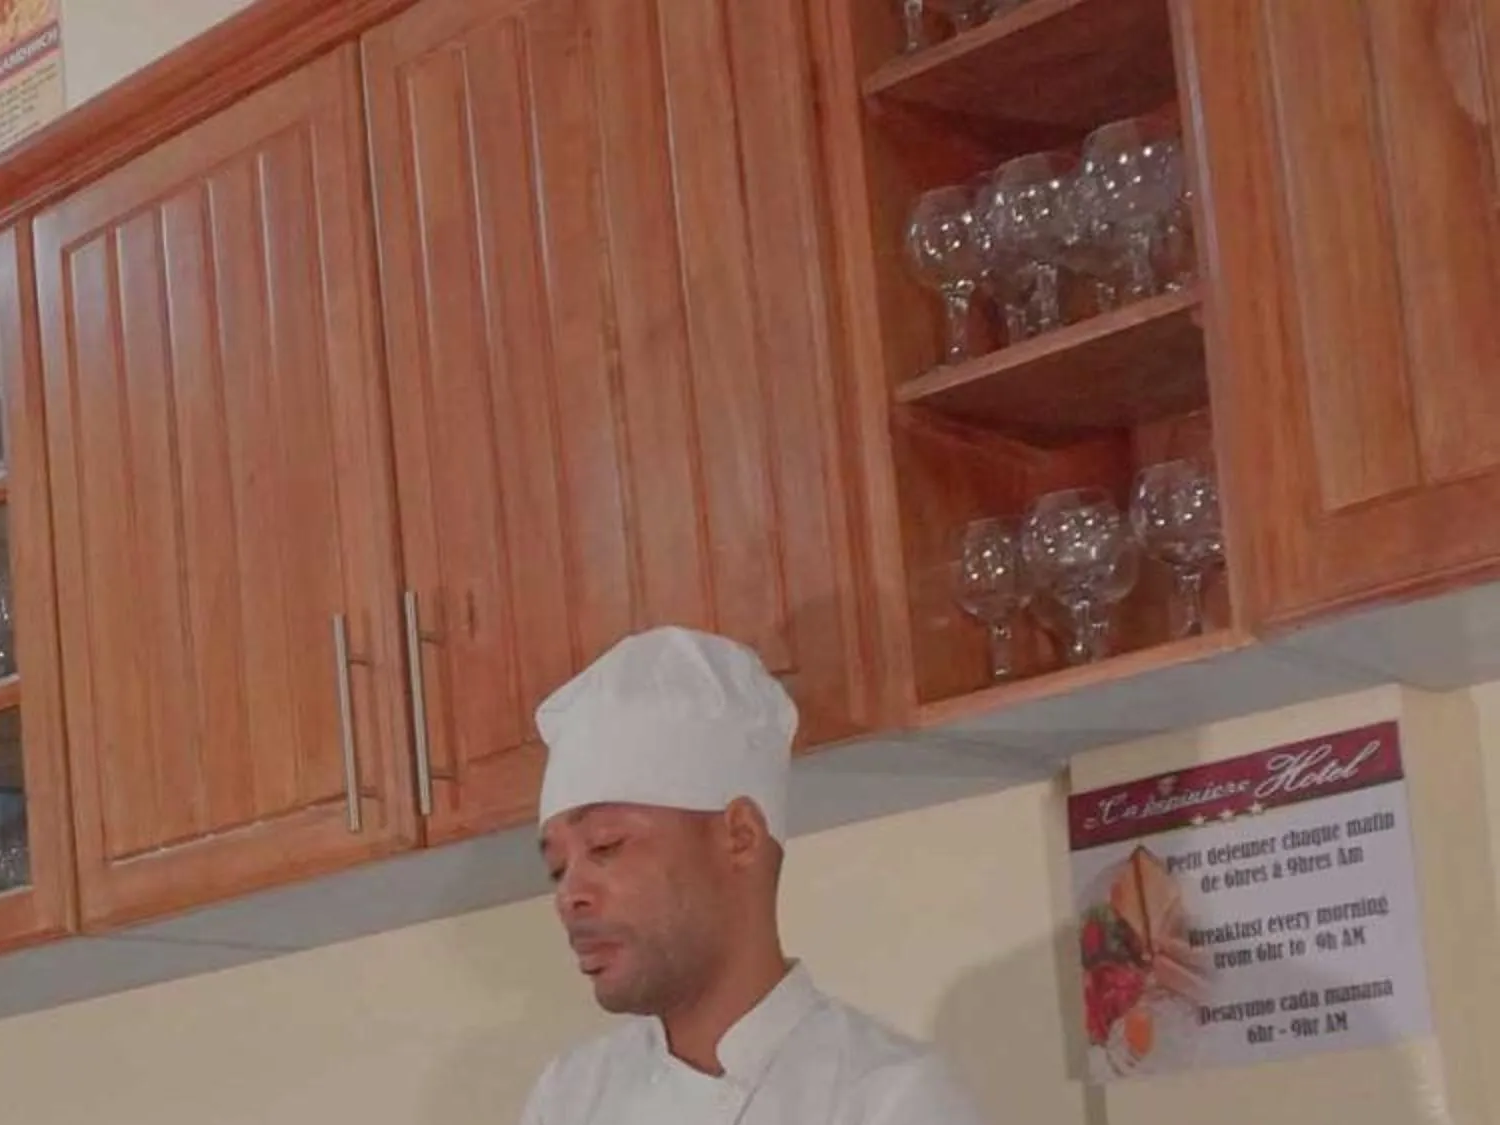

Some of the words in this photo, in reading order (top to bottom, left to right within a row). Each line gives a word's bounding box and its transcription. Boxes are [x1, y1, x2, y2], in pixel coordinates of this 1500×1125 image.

[1254, 740, 1380, 797] Hotel
[1280, 827, 1340, 850] chaque
[1346, 811, 1394, 837] matin
[1200, 877, 1221, 893] de
[1267, 911, 1311, 934] every
[1316, 896, 1389, 924] morning
[1288, 938, 1306, 956] to
[1341, 926, 1366, 946] AM
[1280, 989, 1320, 1011] cada
[1325, 1011, 1349, 1032] AM
